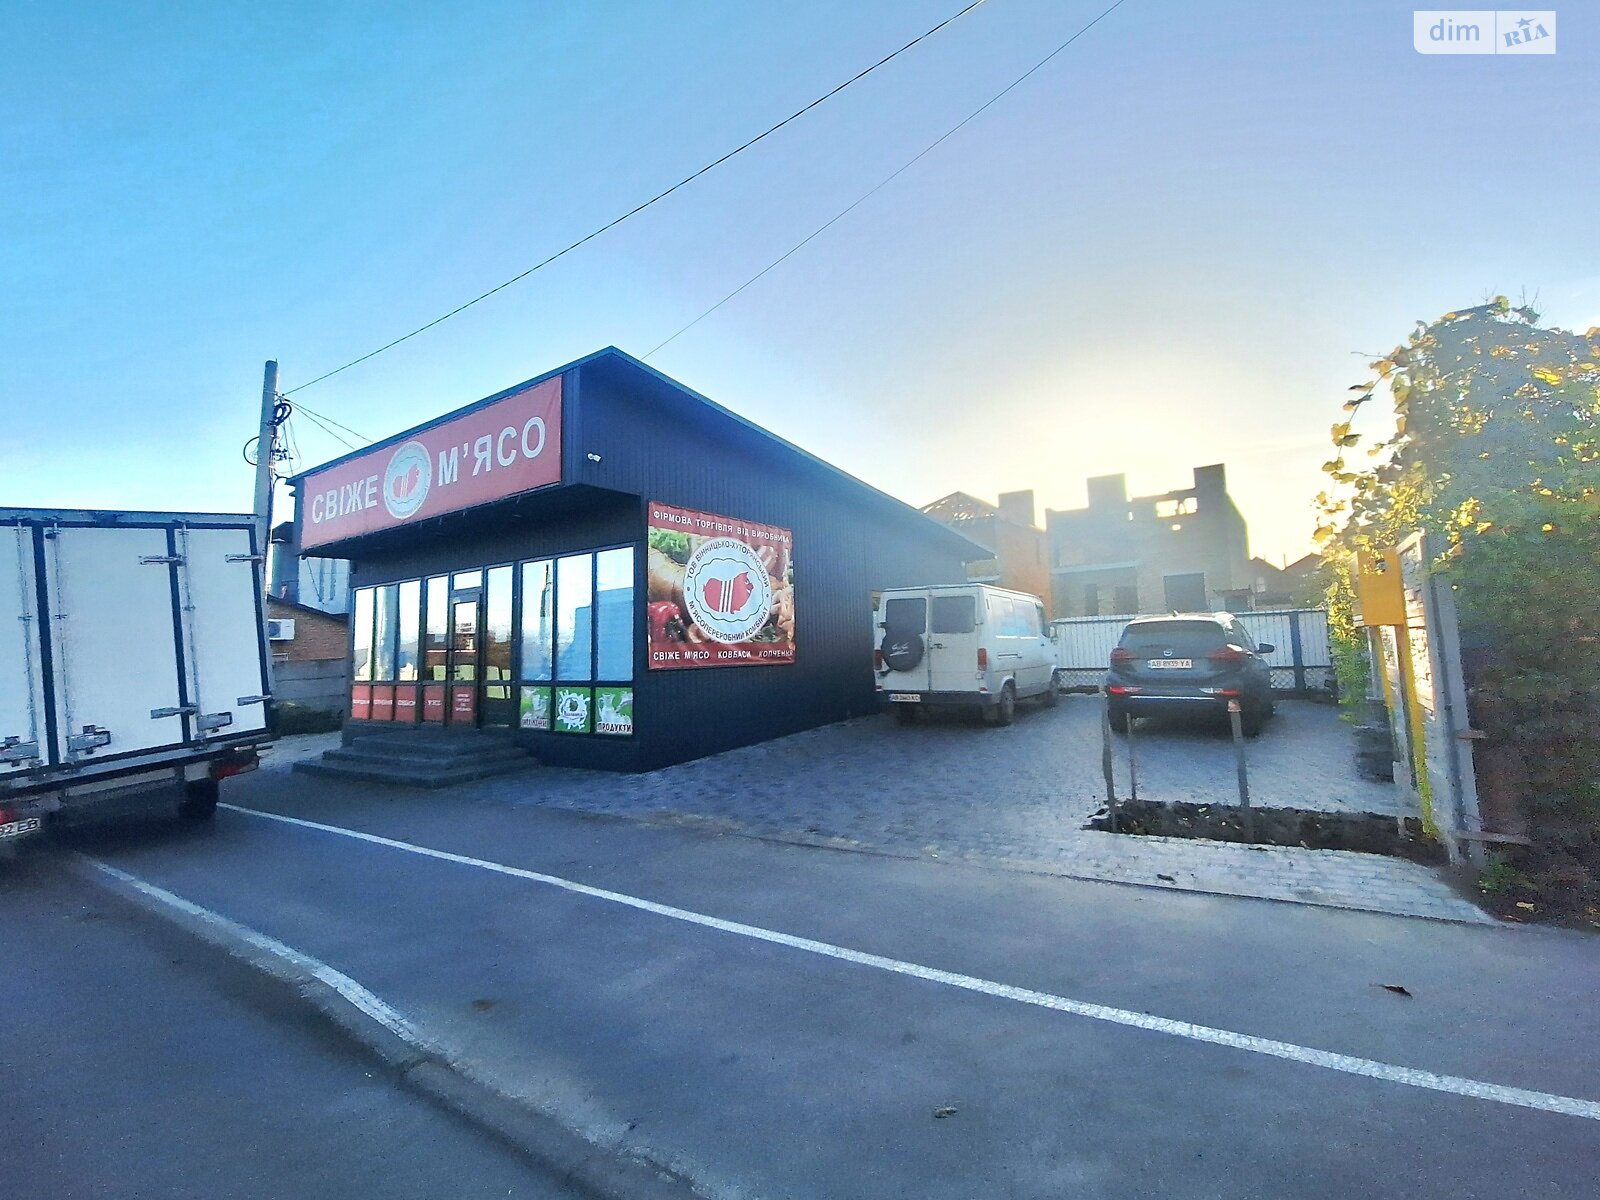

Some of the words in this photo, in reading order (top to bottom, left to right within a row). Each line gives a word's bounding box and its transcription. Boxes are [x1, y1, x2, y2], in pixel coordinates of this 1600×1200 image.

[311, 474, 379, 524] СВІЖЕ
[653, 510, 693, 526] ФІРМОВА
[695, 519, 733, 533] ТОРГІВЛЯ
[737, 528, 750, 538] ВІД
[687, 560, 698, 580] ТОВ
[653, 650, 681, 660] СВІЖЕ
[684, 651, 710, 660] М'ЯСО
[717, 650, 752, 659] КОВБАСИ
